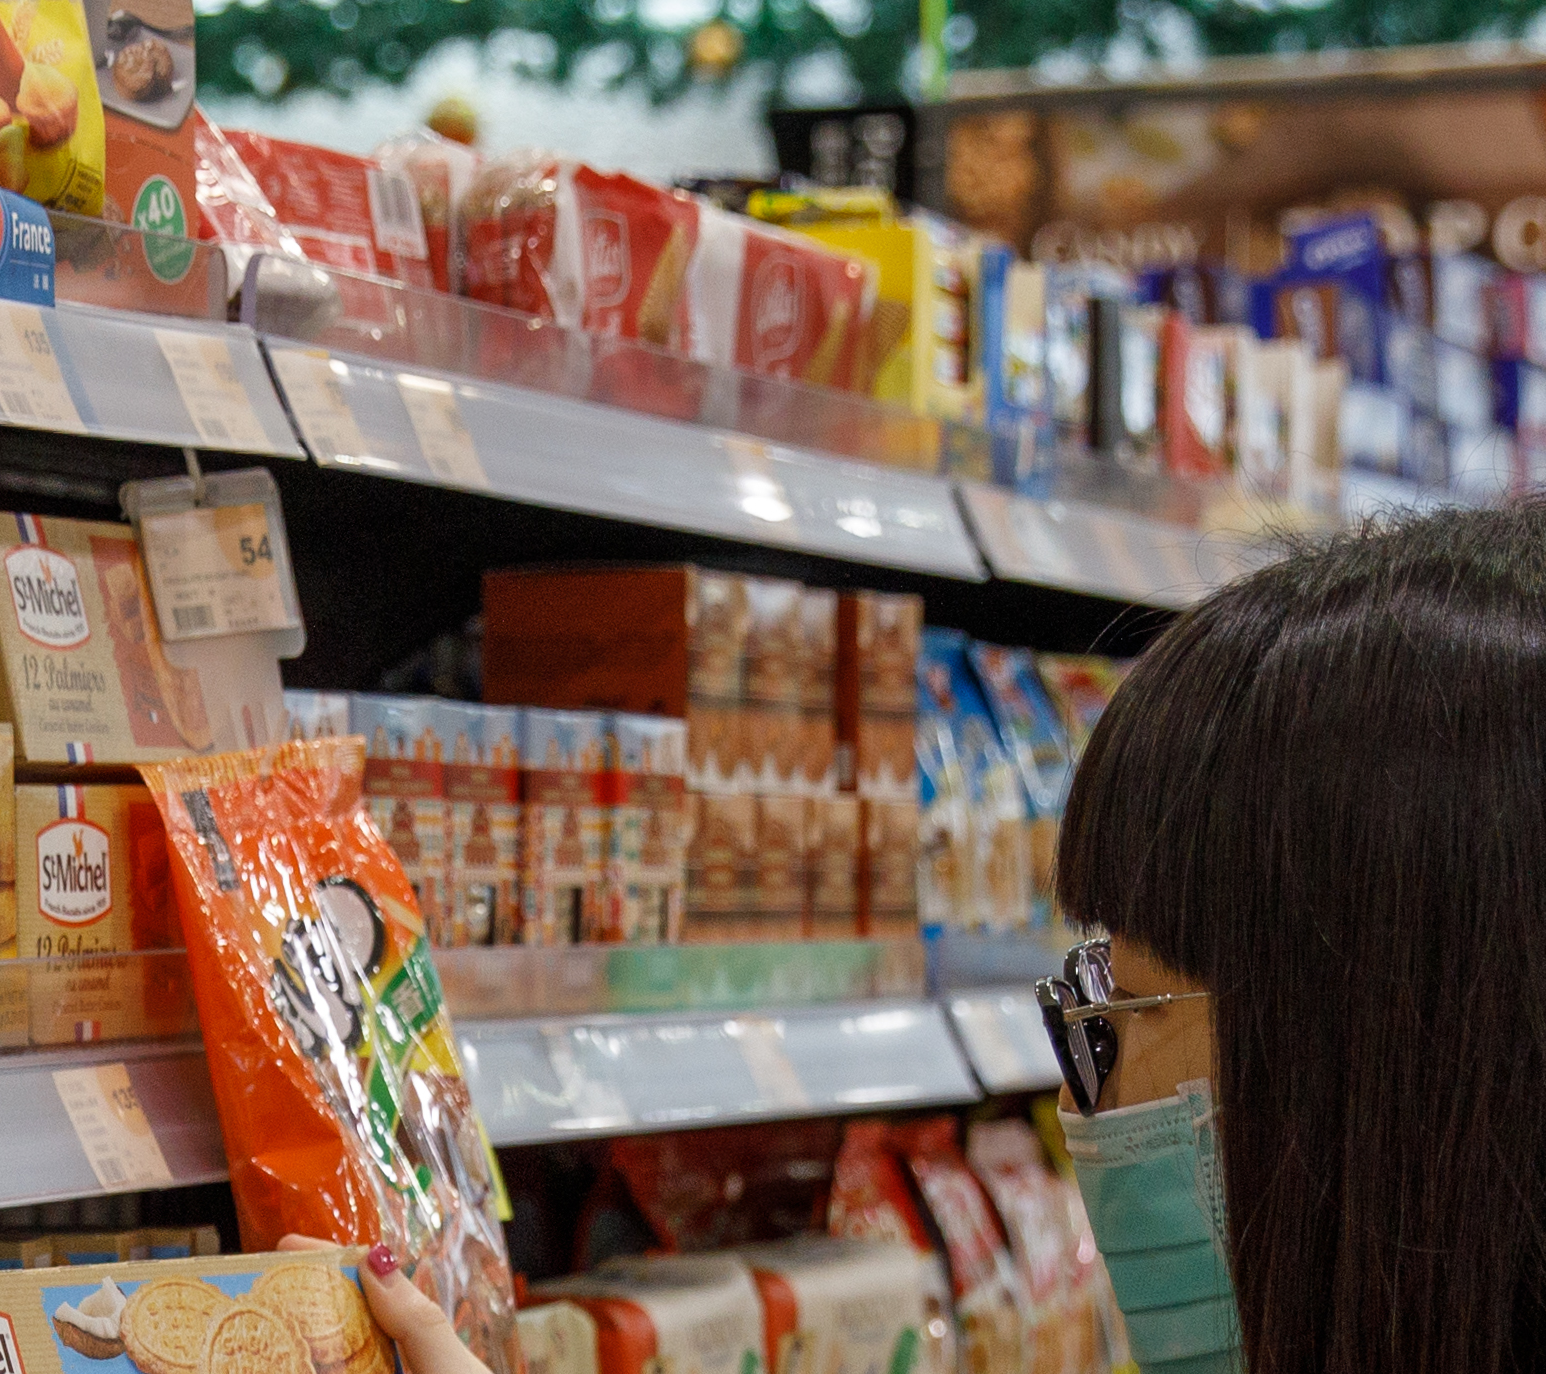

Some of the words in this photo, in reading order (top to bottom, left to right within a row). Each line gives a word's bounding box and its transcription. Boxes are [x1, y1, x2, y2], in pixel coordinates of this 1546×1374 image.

[11, 211, 52, 255] France
[23, 654, 42, 692] 12
[44, 655, 106, 693] Palmiers
